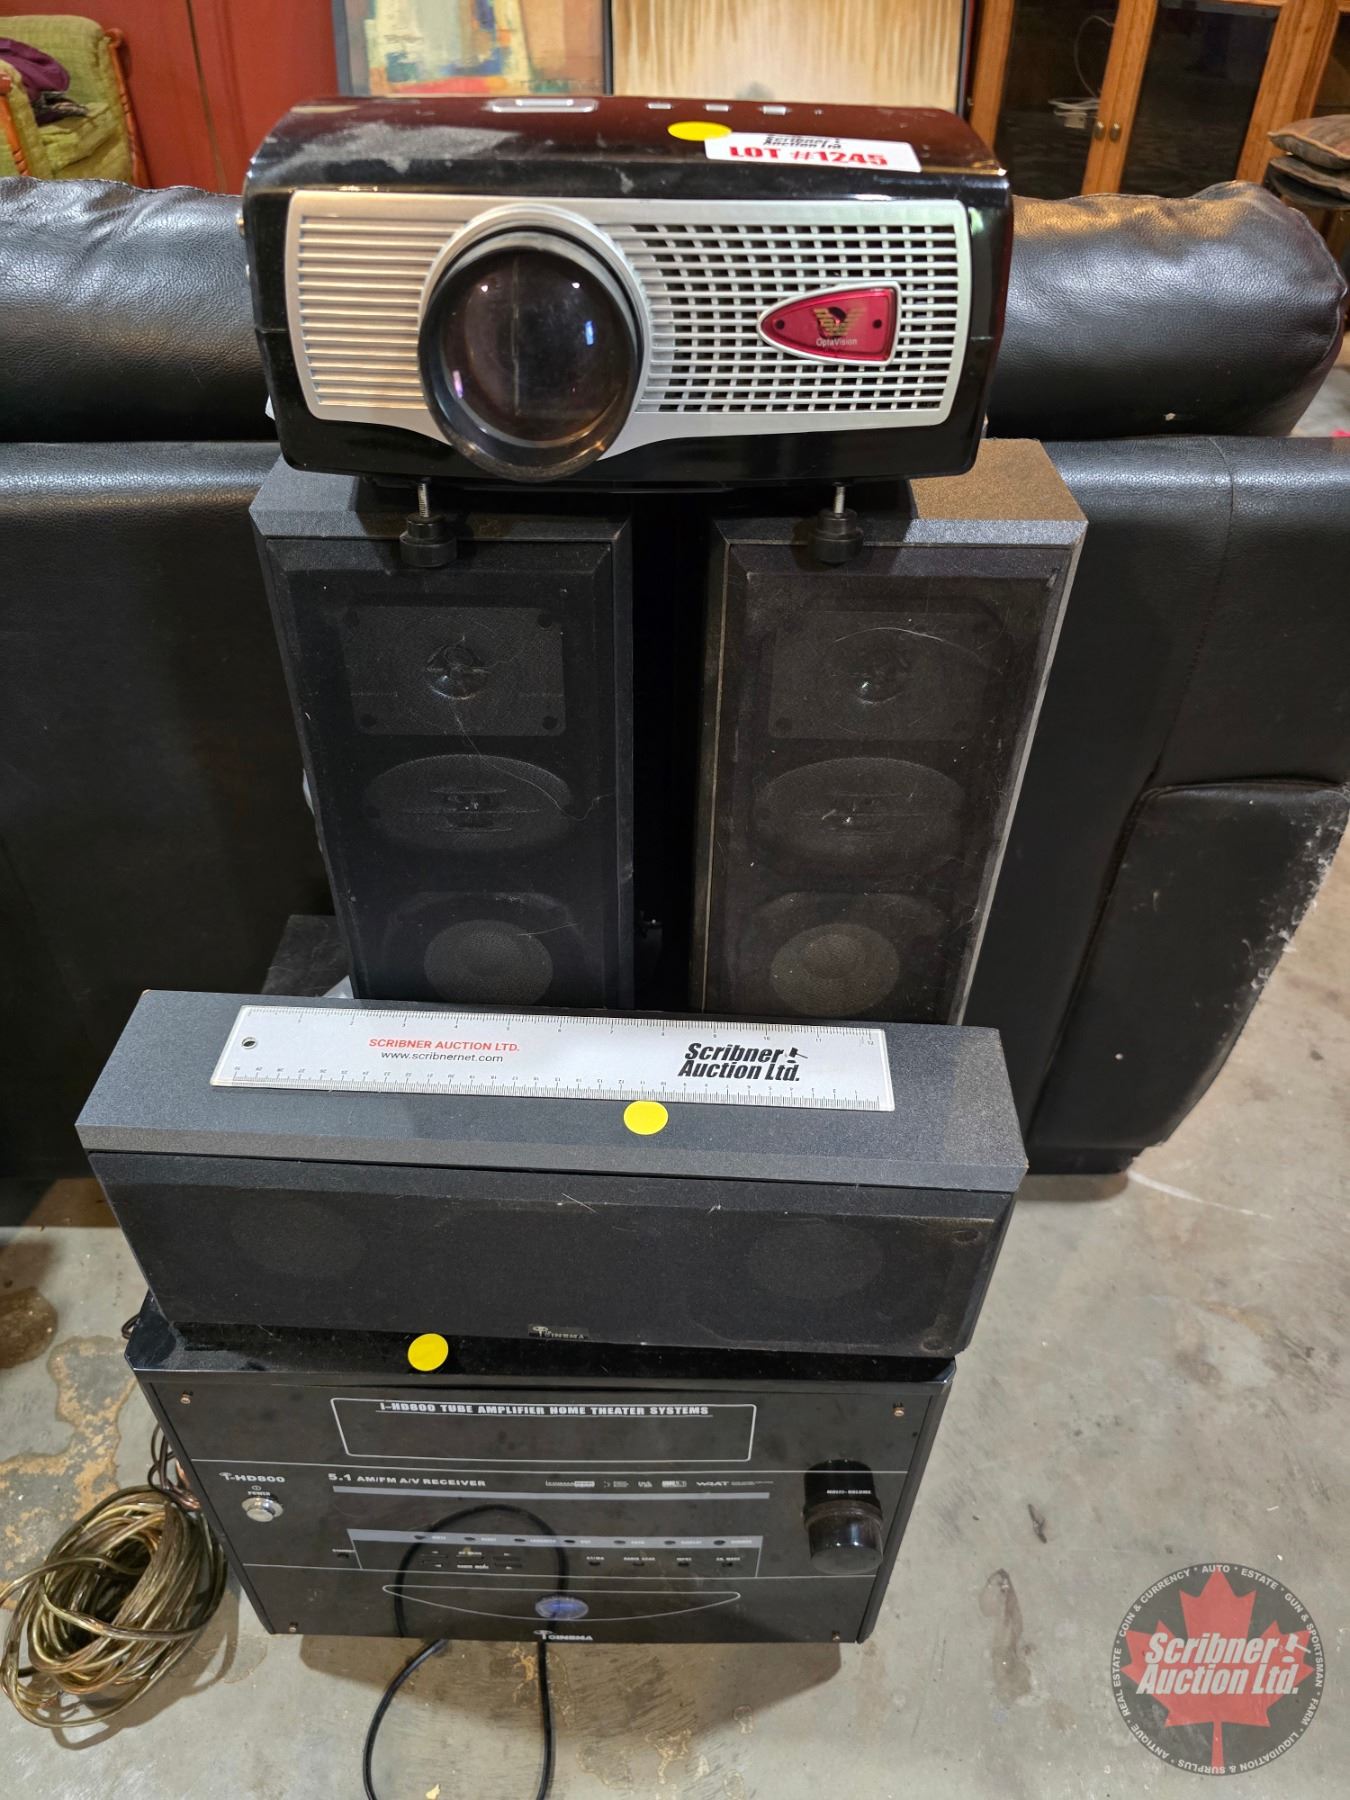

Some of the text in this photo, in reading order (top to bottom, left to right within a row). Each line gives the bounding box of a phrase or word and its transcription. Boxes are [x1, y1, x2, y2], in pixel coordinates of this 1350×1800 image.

[729, 146, 889, 166] LOT #1245
[369, 1038, 520, 1052] SCRIBNER AUCTION LTD.
[381, 1051, 503, 1063] www.scribnernet.com
[684, 1042, 785, 1063] Scribner
[678, 1059, 800, 1082] Auction Ltd.
[440, 1404, 473, 1413] TUBE
[477, 1405, 545, 1415] AMPLIFIER
[549, 1406, 586, 1415] HOME
[590, 1406, 645, 1415] THEATER
[649, 1406, 709, 1415] SYSTEMS
[327, 1473, 486, 1487] 5.1 AM/FM A/V RECEIVER
